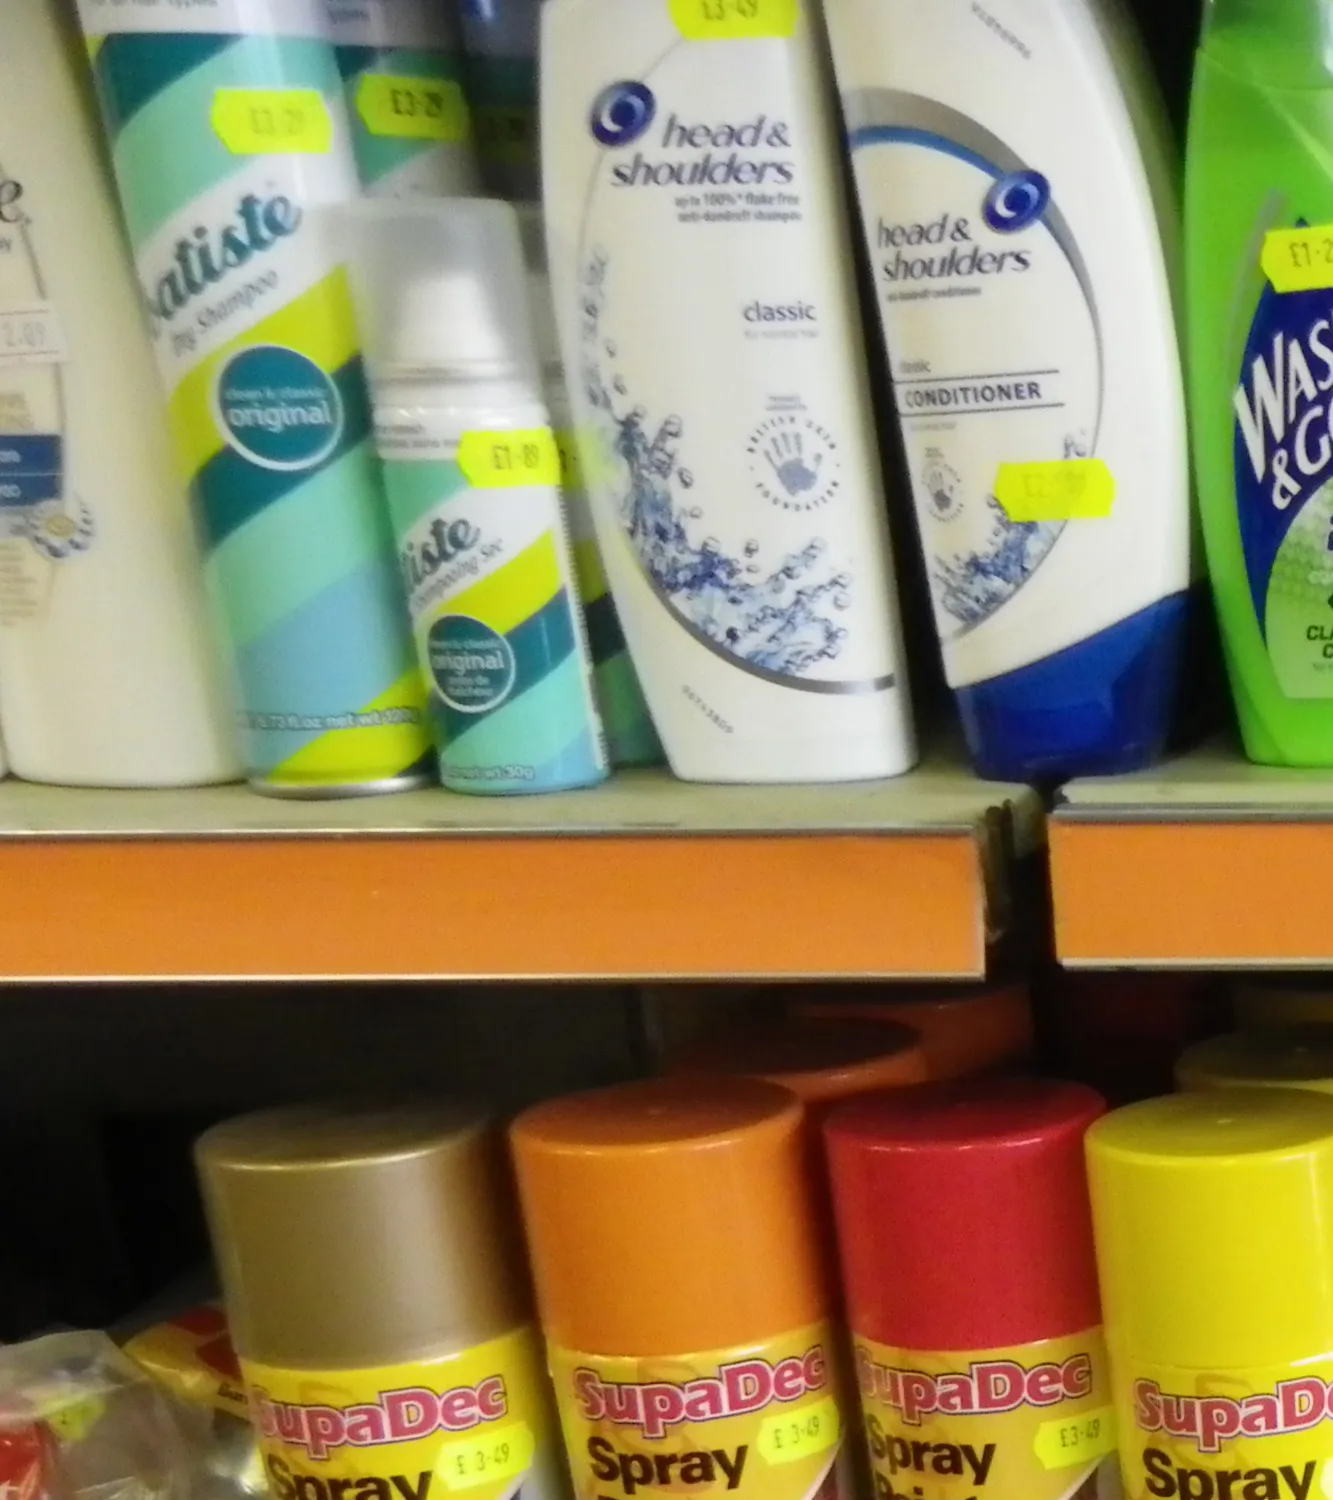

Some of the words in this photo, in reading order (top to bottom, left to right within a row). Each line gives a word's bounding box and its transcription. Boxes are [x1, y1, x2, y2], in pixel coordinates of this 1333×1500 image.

[661, 114, 760, 149] head
[764, 116, 789, 146] &
[610, 152, 794, 187] shoulders
[946, 219, 971, 243] &
[882, 248, 1030, 282] shoulders
[743, 301, 817, 323] classic
[903, 382, 1042, 408] CONDITIONER
[228, 401, 331, 433] original
[573, 1344, 827, 1440] SupaDec
[587, 1436, 749, 1495] Spray
